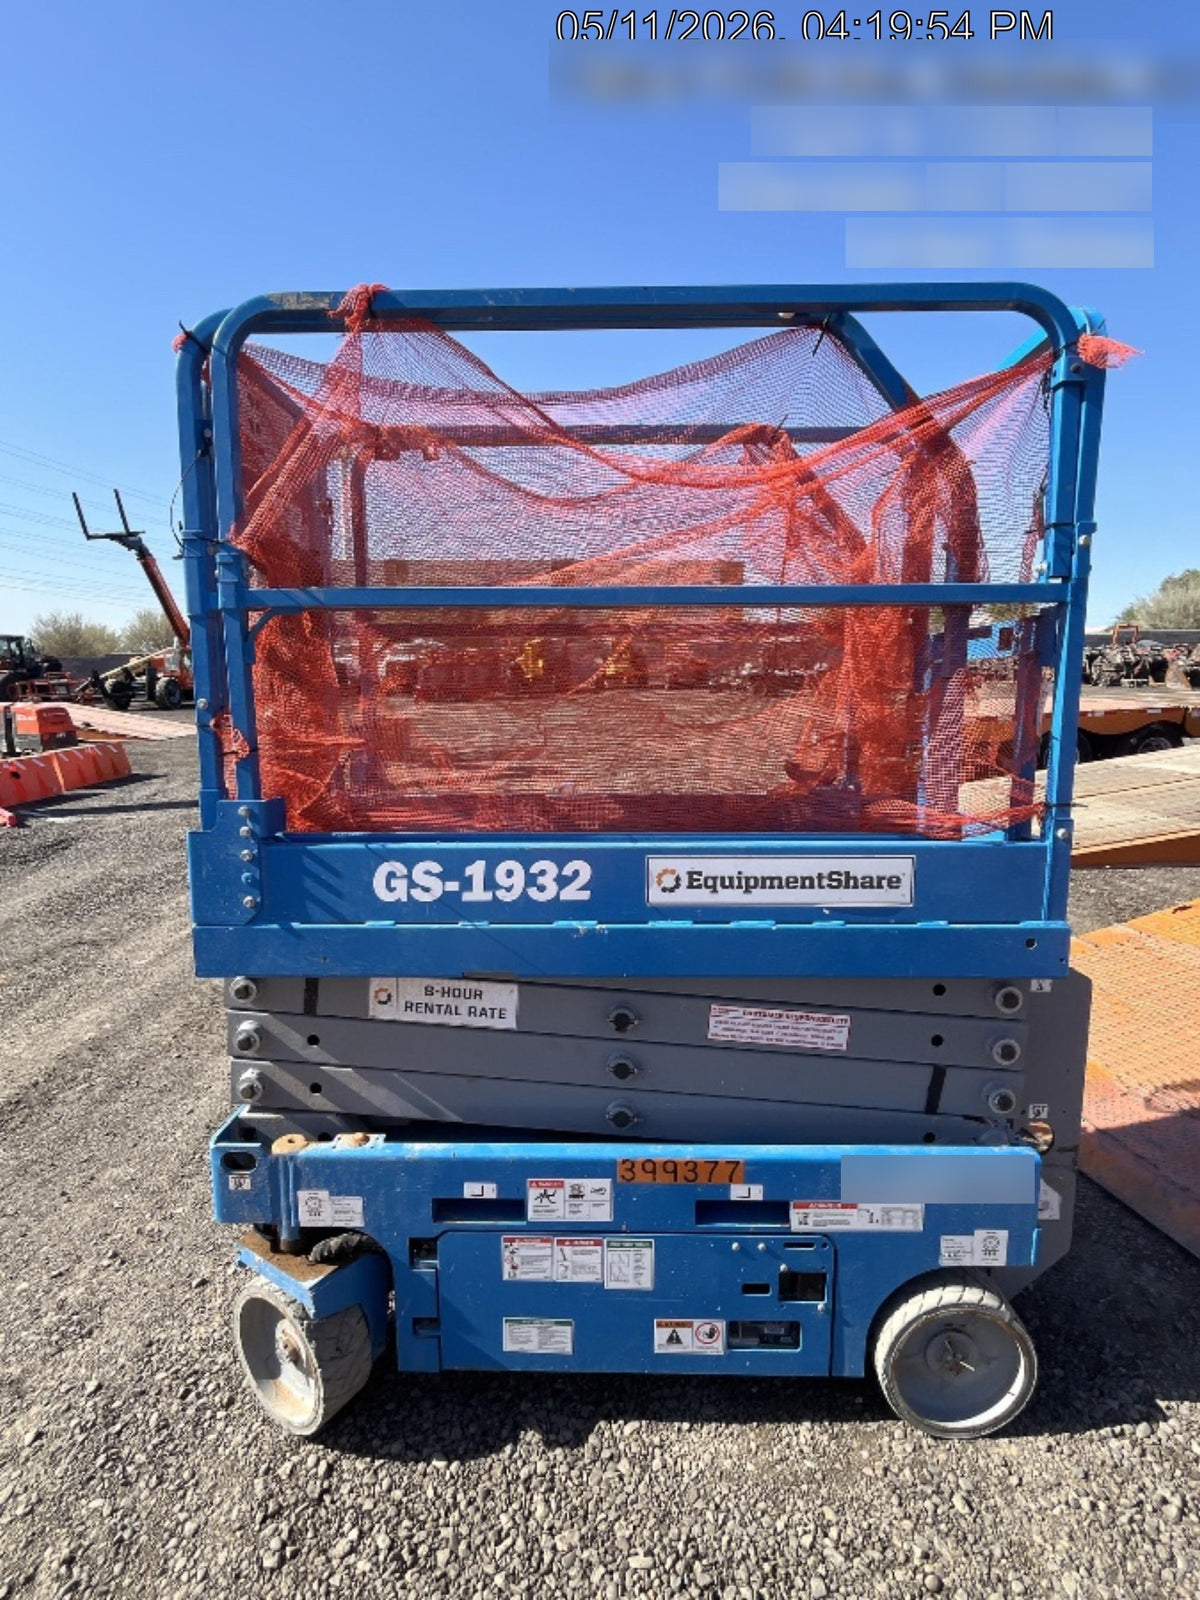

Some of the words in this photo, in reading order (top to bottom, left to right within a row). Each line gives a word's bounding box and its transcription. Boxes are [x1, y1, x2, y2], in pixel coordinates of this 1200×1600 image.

[372, 860, 592, 902] GS-1932
[686, 870, 902, 893] EquipmentShare
[424, 985, 483, 1000] 8-HOUR
[404, 1001, 462, 1016] RENTAL
[468, 1005, 507, 1019] RATE
[620, 1159, 740, 1183] 399377
